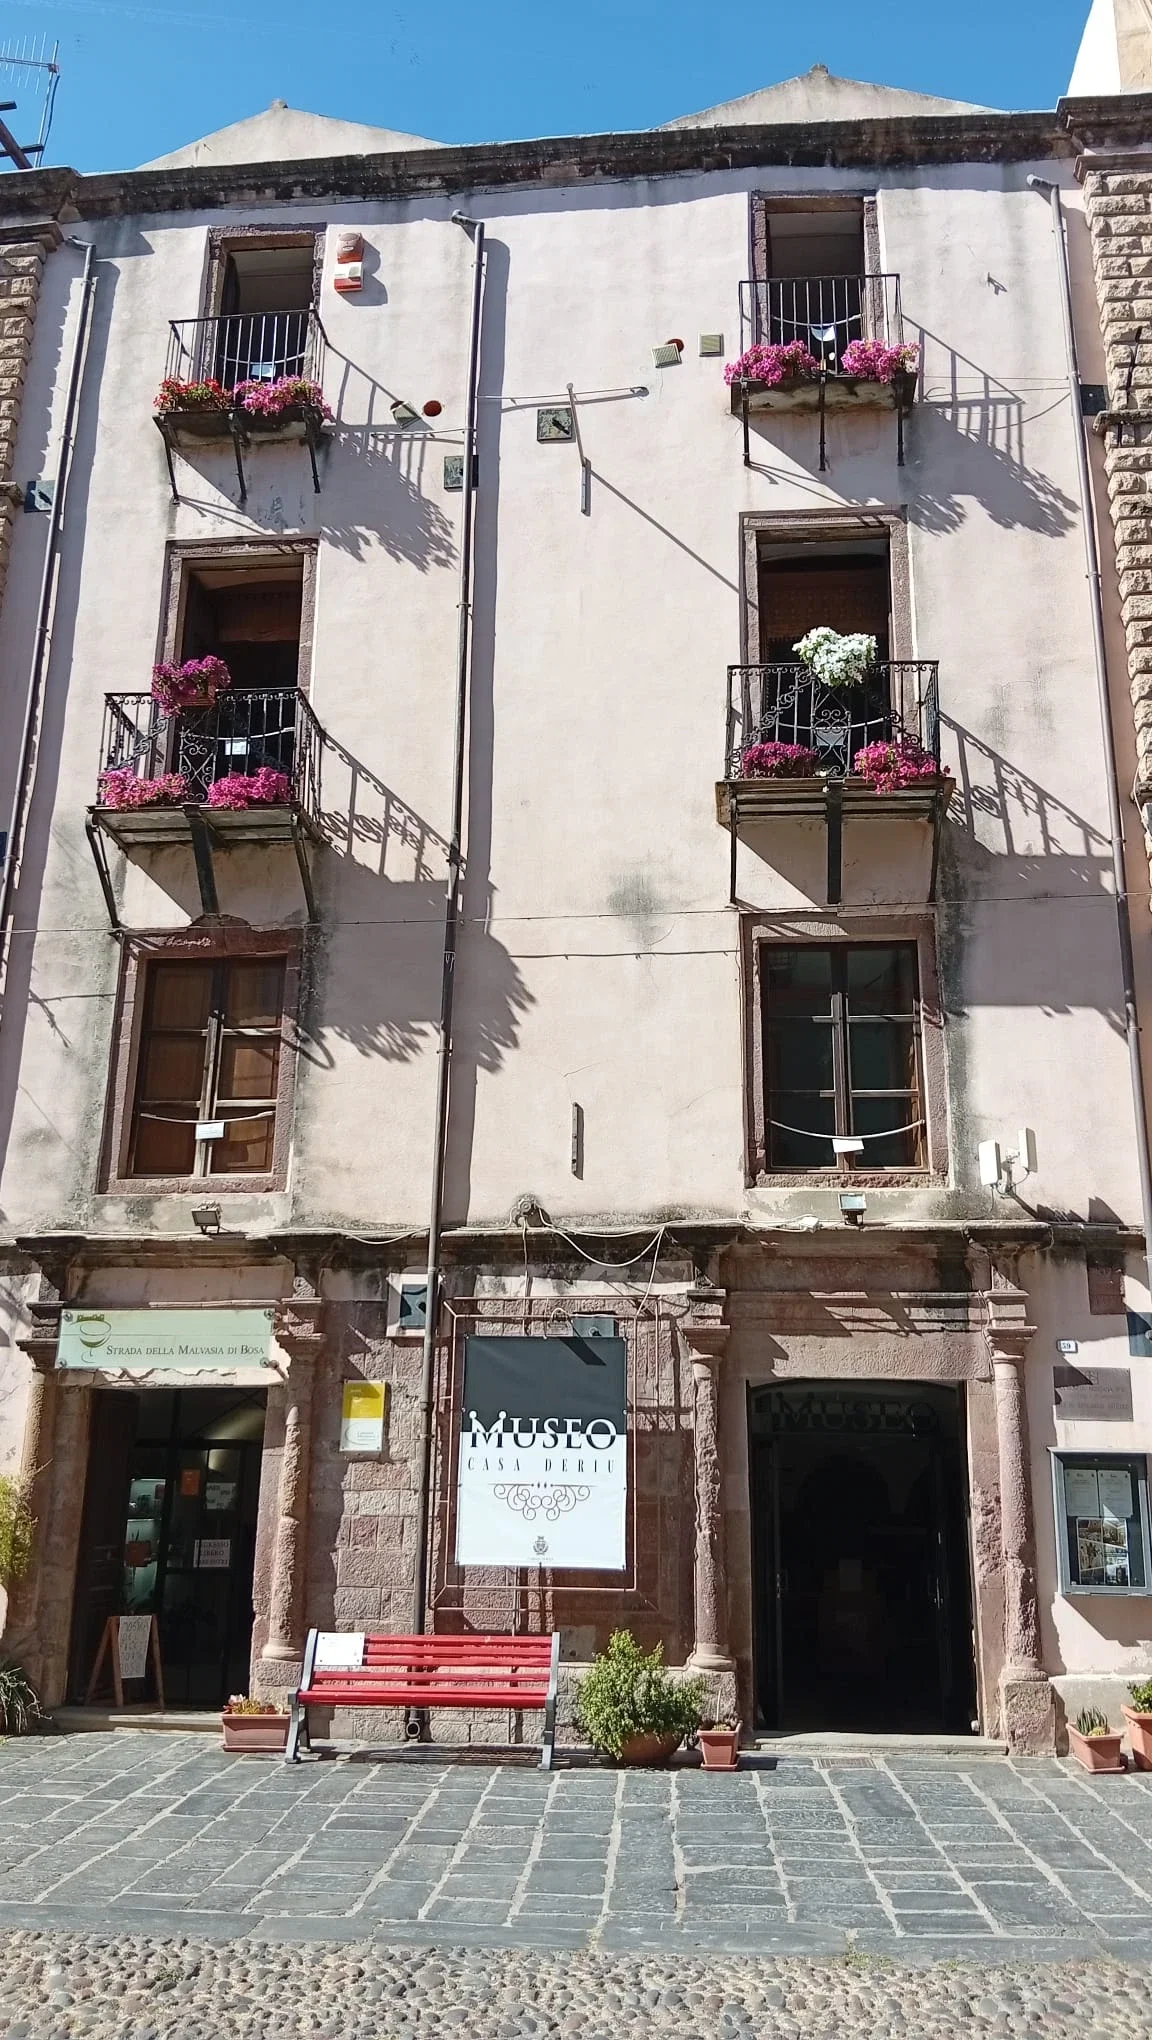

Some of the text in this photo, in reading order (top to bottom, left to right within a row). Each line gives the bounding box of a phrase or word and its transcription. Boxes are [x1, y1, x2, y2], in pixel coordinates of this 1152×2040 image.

[106, 1345, 265, 1355] STRADA DELLA MALVASIA DI BOSA
[469, 1410, 617, 1450] MUSEO
[468, 1457, 615, 1473] CASA DERIU
